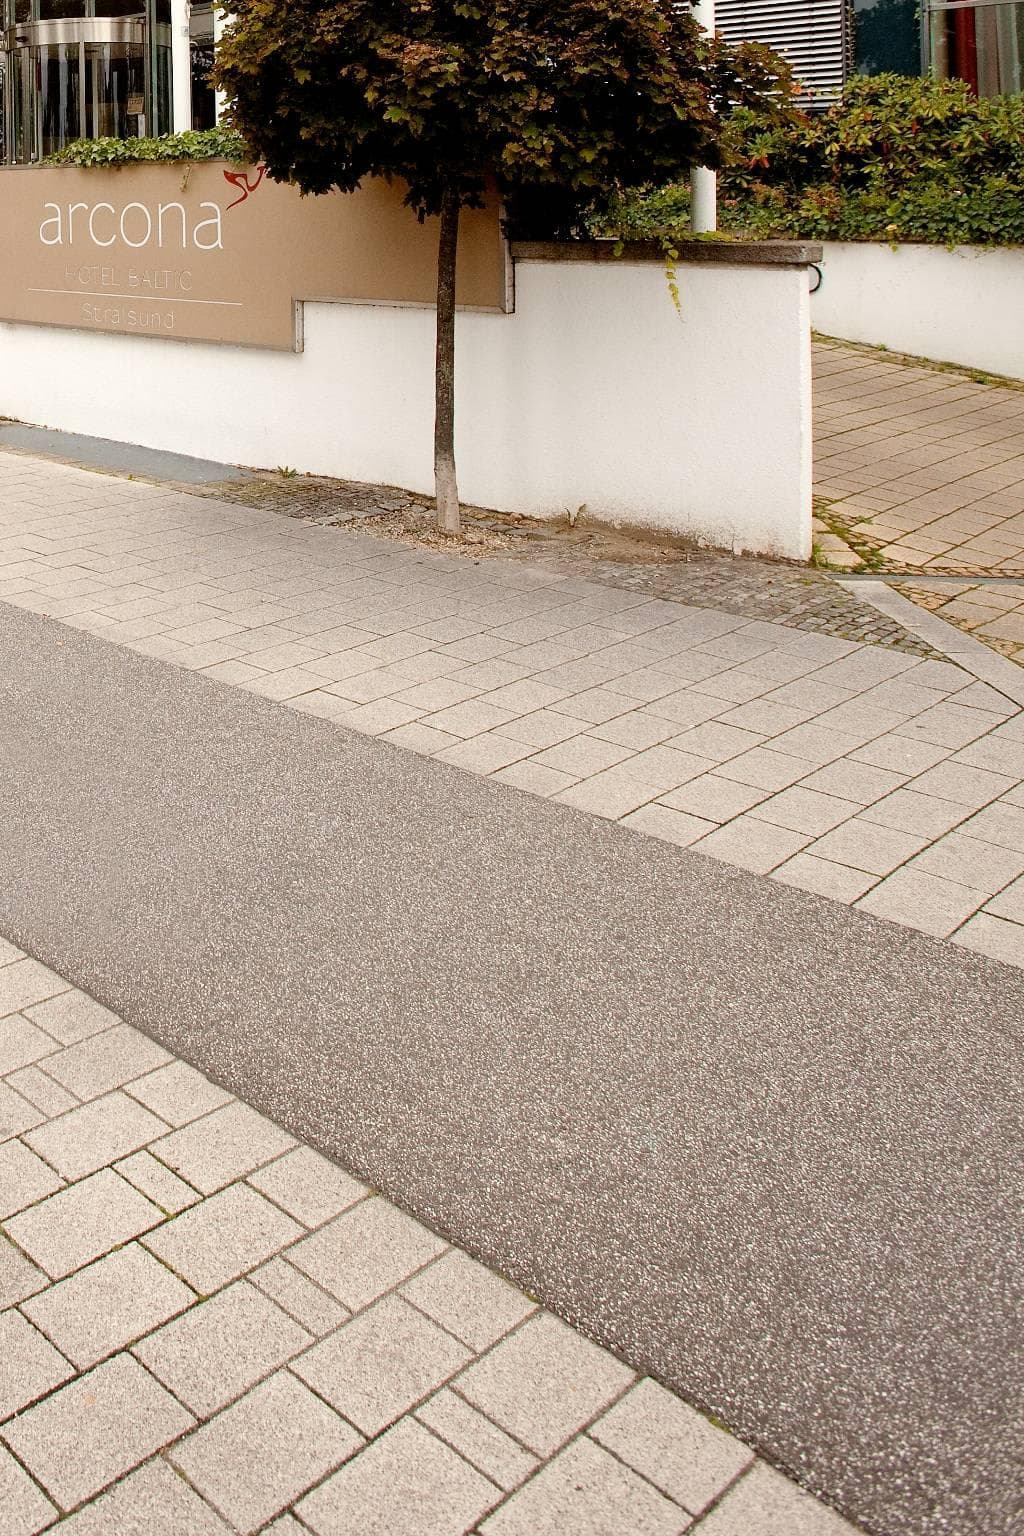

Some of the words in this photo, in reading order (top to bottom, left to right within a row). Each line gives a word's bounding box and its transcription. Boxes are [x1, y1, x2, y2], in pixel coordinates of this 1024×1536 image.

[39, 200, 225, 250] arcona
[64, 264, 121, 286] HOTEL
[127, 268, 193, 291] BALTIC
